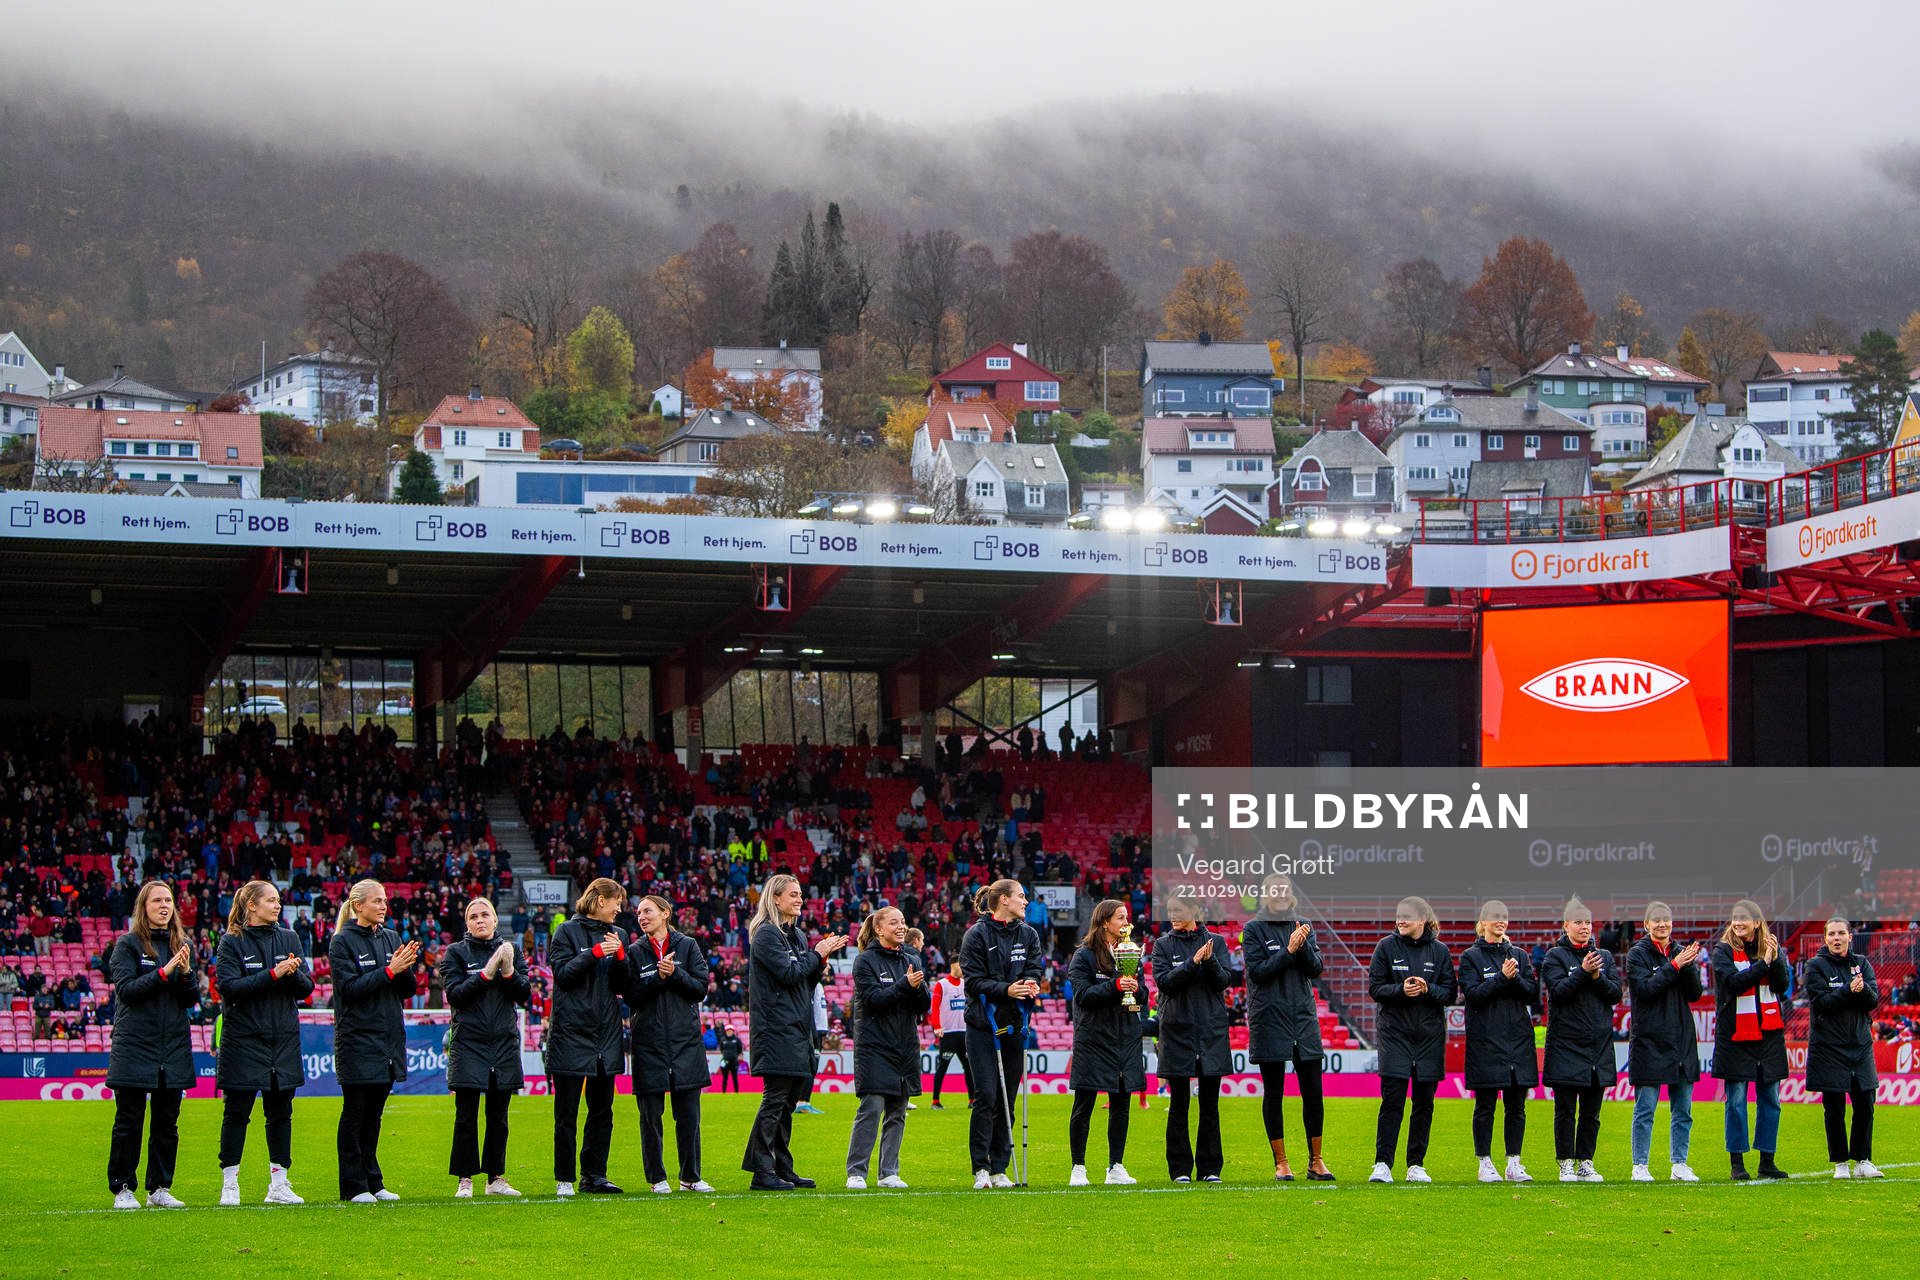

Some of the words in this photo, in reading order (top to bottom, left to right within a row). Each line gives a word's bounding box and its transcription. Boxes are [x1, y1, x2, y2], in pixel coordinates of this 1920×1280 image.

[43, 507, 86, 525] BOB
[122, 515, 150, 528] Rett
[153, 516, 191, 532] hjem.
[247, 515, 290, 533] BOB
[314, 522, 342, 534] Rett
[345, 523, 381, 538] hjem.
[446, 521, 488, 539] BOB
[511, 528, 538, 541] Rett
[541, 529, 577, 544] hjem.
[630, 528, 671, 545] BOB
[1814, 515, 1877, 548] Fjordkraft
[703, 535, 729, 547] Rett
[732, 536, 767, 551] hjem.
[819, 535, 858, 552] BOB
[880, 542, 907, 554] Rett
[910, 543, 943, 557] hjem.
[1002, 541, 1040, 558] BOB
[1062, 548, 1087, 560] Rett
[1090, 549, 1122, 564] hjem.
[1172, 548, 1209, 564] BOB
[1238, 555, 1262, 567] Rett
[1265, 556, 1297, 570] hjem.
[1345, 555, 1381, 571] BOB
[1543, 549, 1649, 579] Fjordkraft
[1555, 672, 1653, 698] BRANN
[1327, 844, 1424, 867] Fjordkraft
[1556, 842, 1656, 866] Fjordkraft
